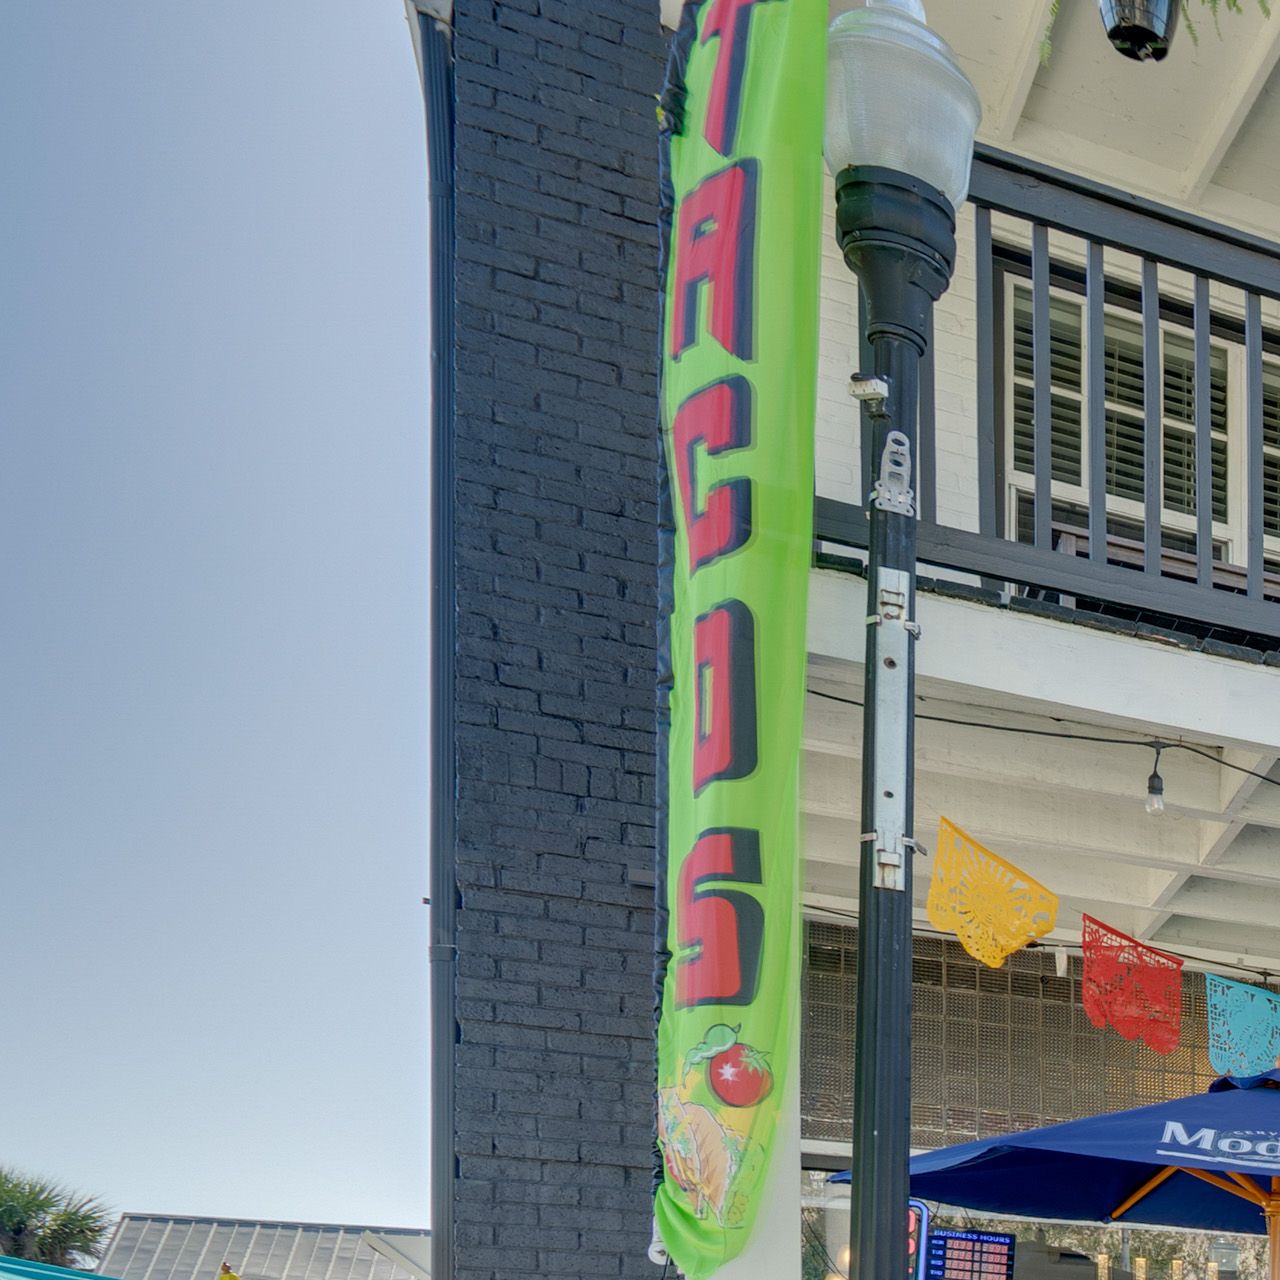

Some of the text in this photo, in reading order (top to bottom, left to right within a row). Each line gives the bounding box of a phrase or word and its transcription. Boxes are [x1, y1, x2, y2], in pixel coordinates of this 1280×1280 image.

[670, 0, 766, 1010] TACOS
[934, 1229, 1011, 1244] BUSINESS HOURS
